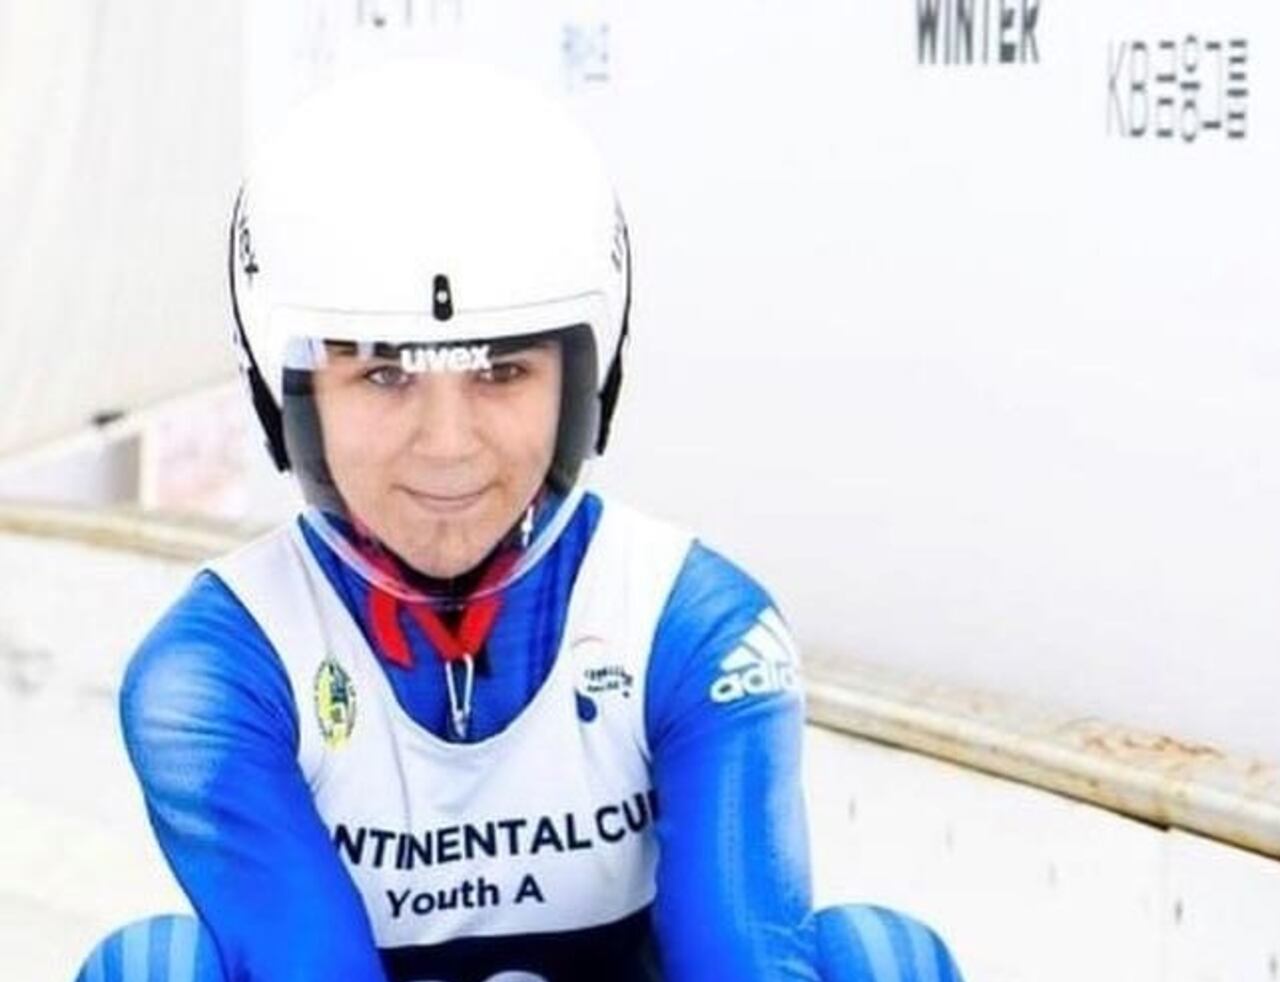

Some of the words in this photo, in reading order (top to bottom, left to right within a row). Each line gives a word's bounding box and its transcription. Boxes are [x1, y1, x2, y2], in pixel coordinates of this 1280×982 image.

[915, 0, 1040, 65] WINTER
[401, 345, 492, 373] uvex
[333, 812, 592, 871] NTINENTAL
[386, 876, 500, 919] Youth
[513, 873, 546, 905] A
